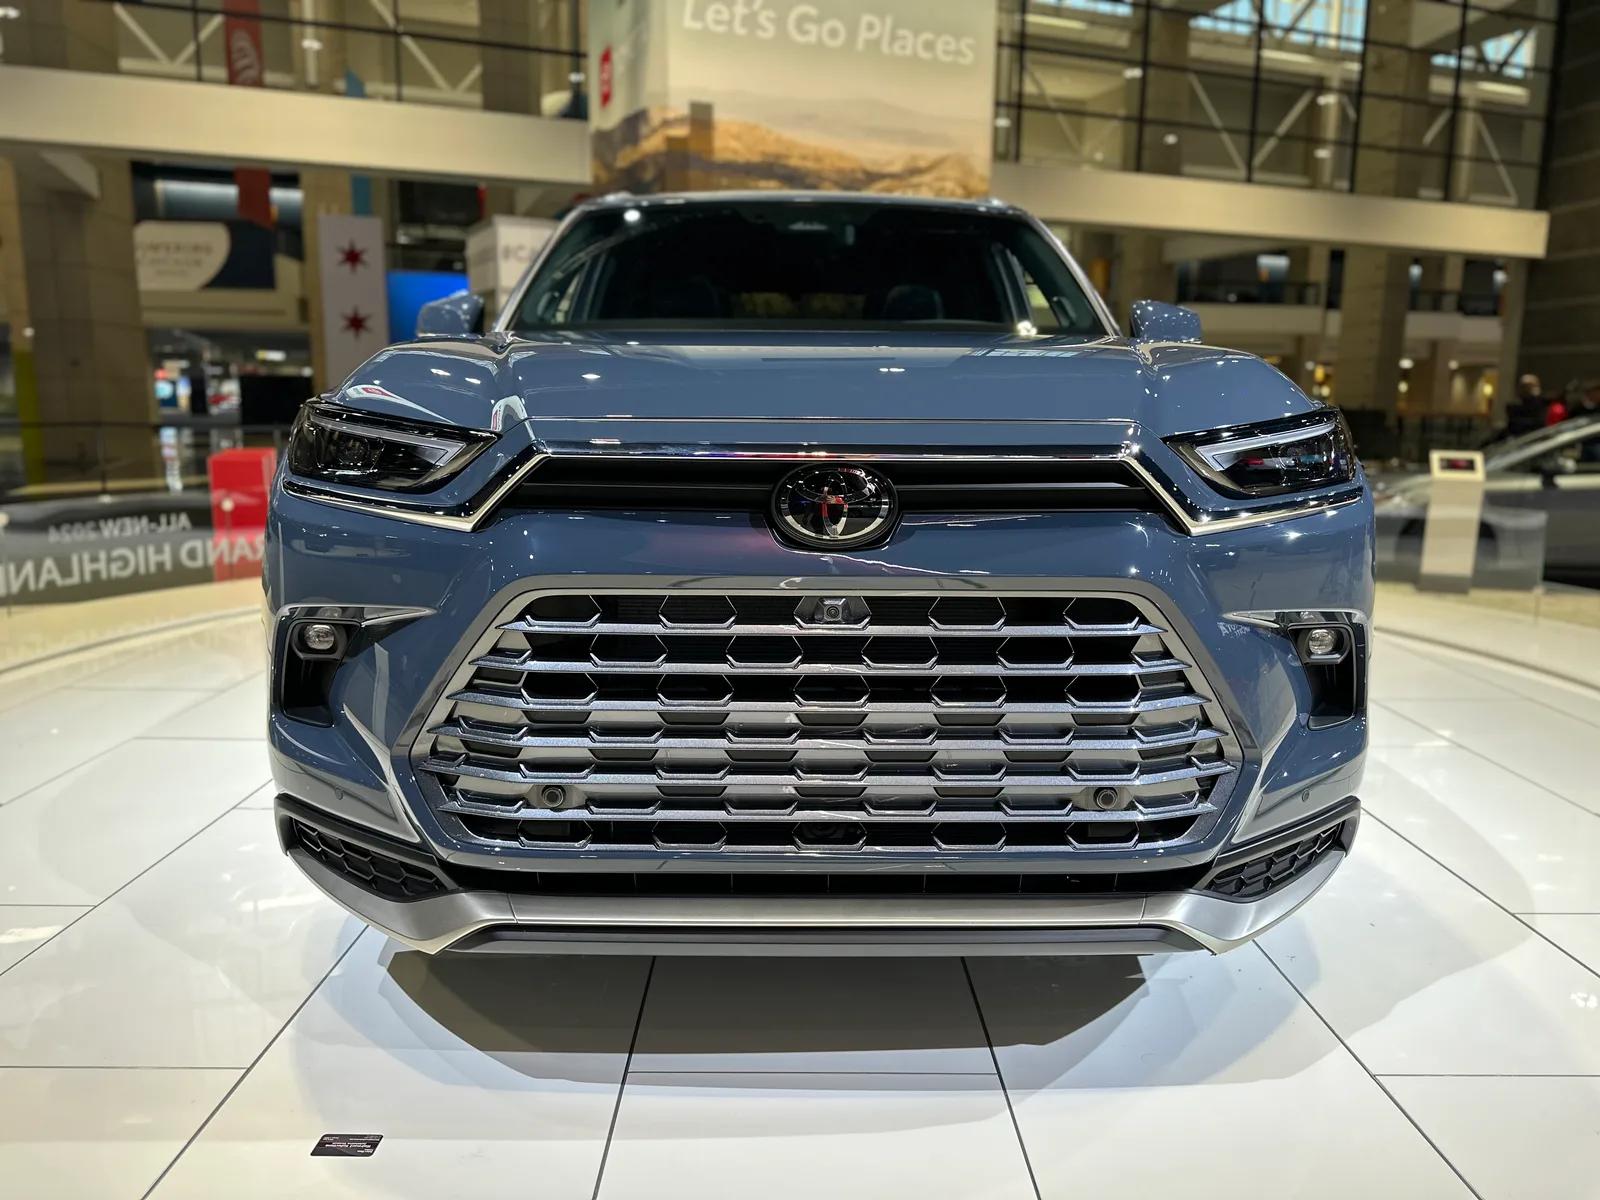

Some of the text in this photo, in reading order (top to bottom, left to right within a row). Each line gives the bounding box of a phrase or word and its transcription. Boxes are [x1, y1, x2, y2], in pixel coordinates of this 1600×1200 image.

[682, 0, 976, 65] Let's Go Places
